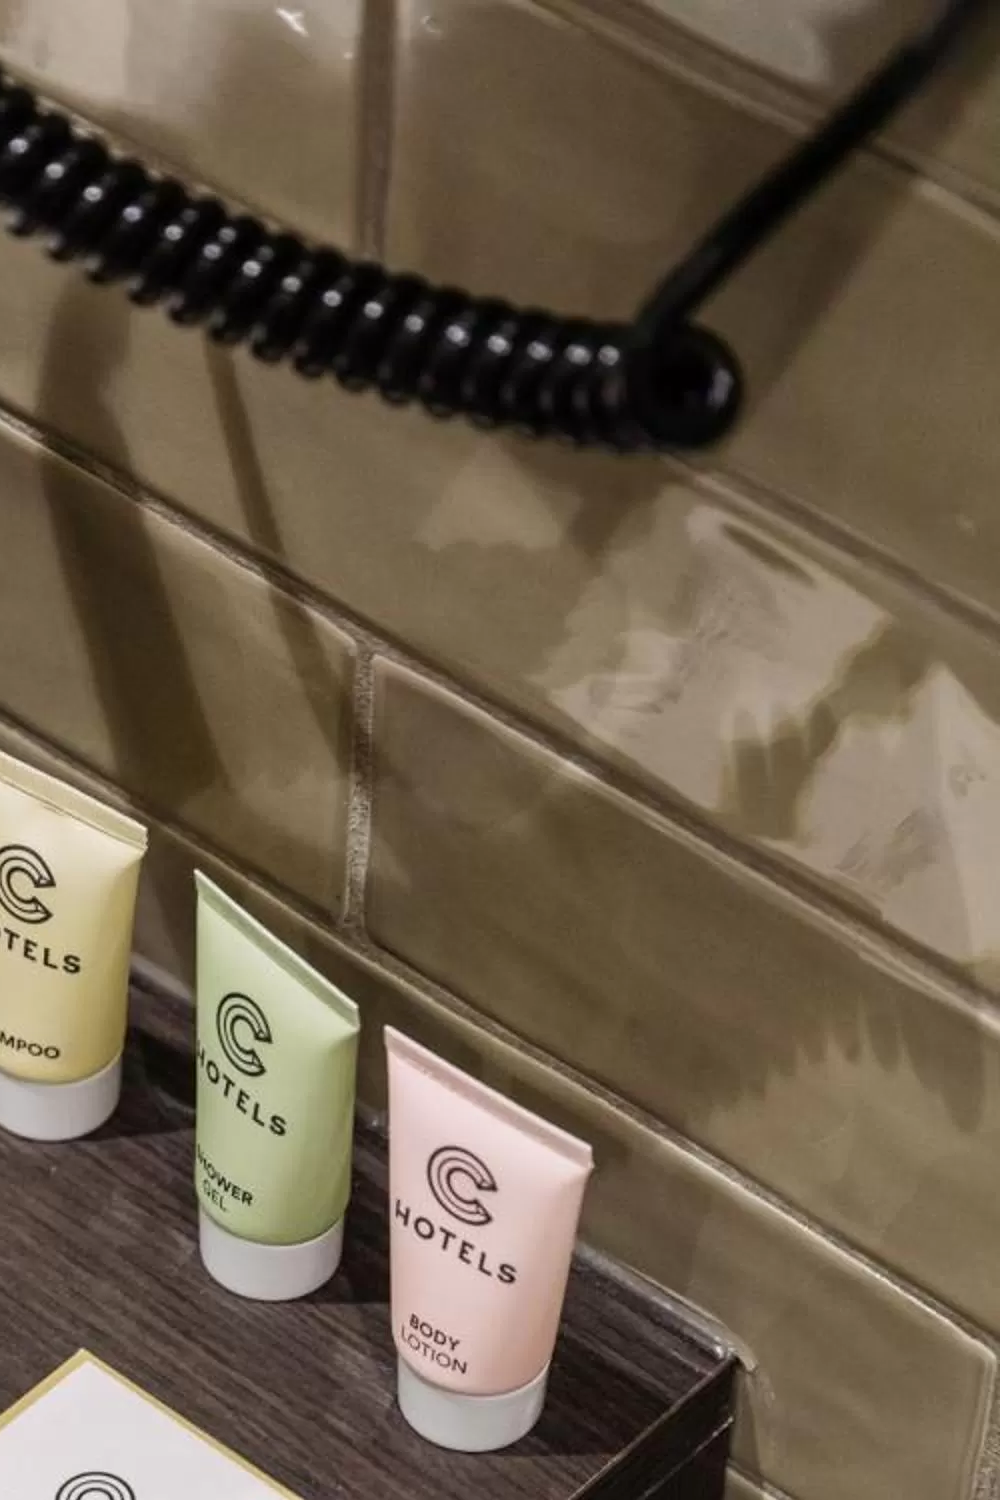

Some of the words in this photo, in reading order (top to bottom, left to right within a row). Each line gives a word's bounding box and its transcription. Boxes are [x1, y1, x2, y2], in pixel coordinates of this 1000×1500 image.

[203, 1179, 228, 1213] GEL
[396, 1200, 517, 1285] HOTELS
[401, 1322, 468, 1375] LOTION
[409, 1312, 461, 1352] BODY
